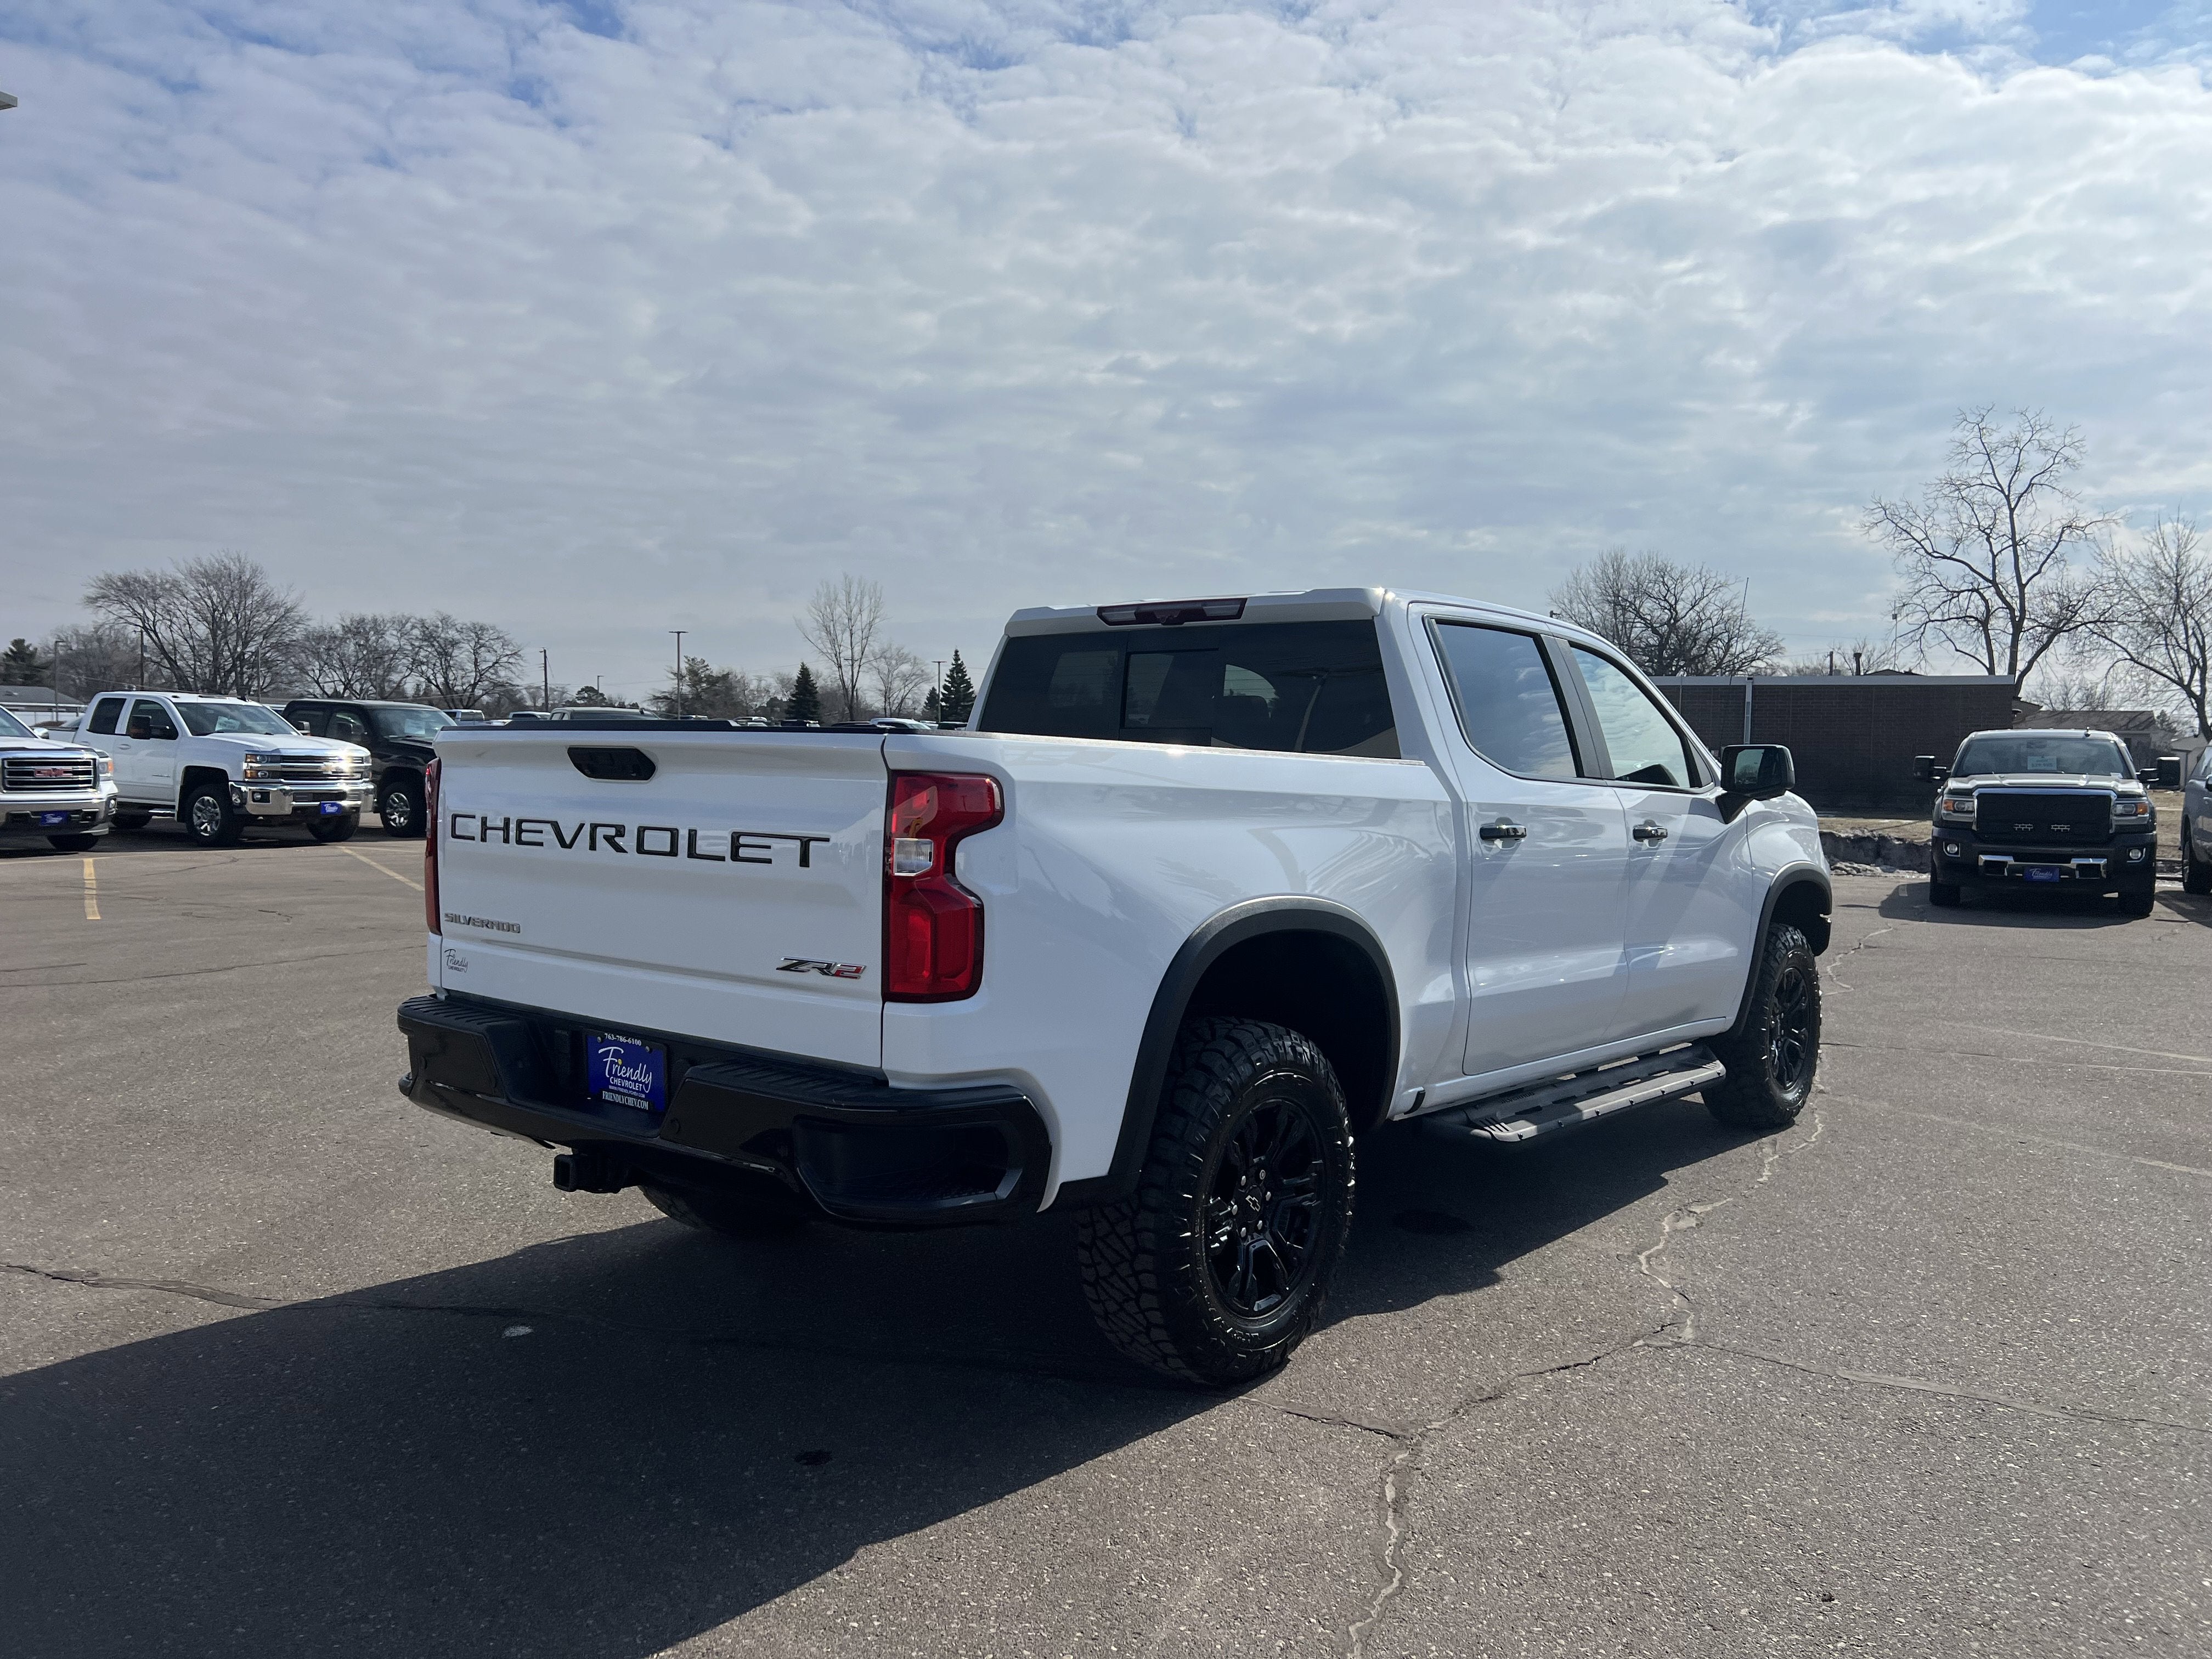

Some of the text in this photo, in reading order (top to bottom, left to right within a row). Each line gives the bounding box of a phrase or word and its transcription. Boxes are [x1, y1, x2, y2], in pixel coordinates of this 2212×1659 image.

[450, 813, 830, 868] CHEVROLET
[444, 912, 521, 934] SILVERADO
[444, 949, 469, 973] Friendly
[776, 956, 867, 979] ZR2
[604, 1033, 642, 1046] 763-786-6100
[598, 1046, 652, 1093] Friendly
[610, 1076, 642, 1091] CHEVROLET
[602, 1091, 648, 1110] FRIENDLYCHEV.COM
